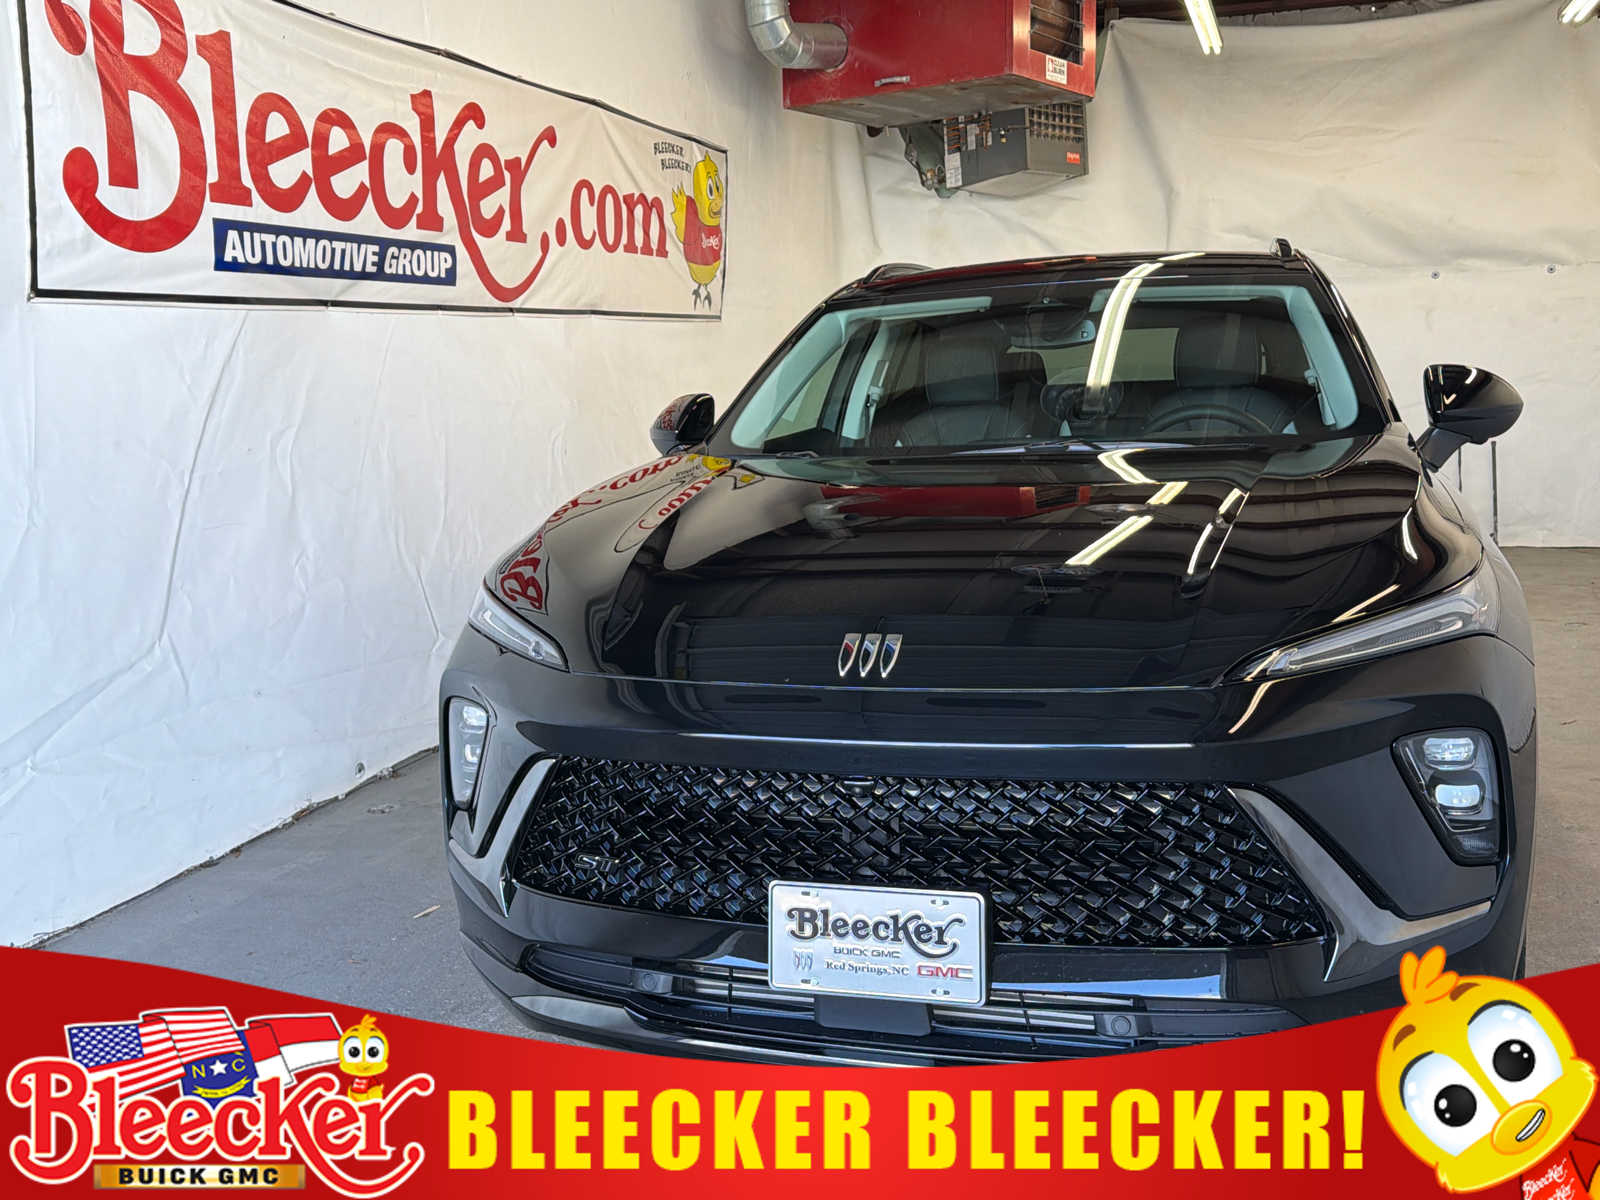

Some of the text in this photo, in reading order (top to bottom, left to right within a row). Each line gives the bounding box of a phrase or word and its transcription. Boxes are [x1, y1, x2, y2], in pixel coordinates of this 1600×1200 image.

[223, 229, 453, 278] AUTOMOTIVE GROUP
[833, 946, 901, 959] BUICK GMC
[825, 960, 847, 971] Red
[917, 964, 974, 979] GMC
